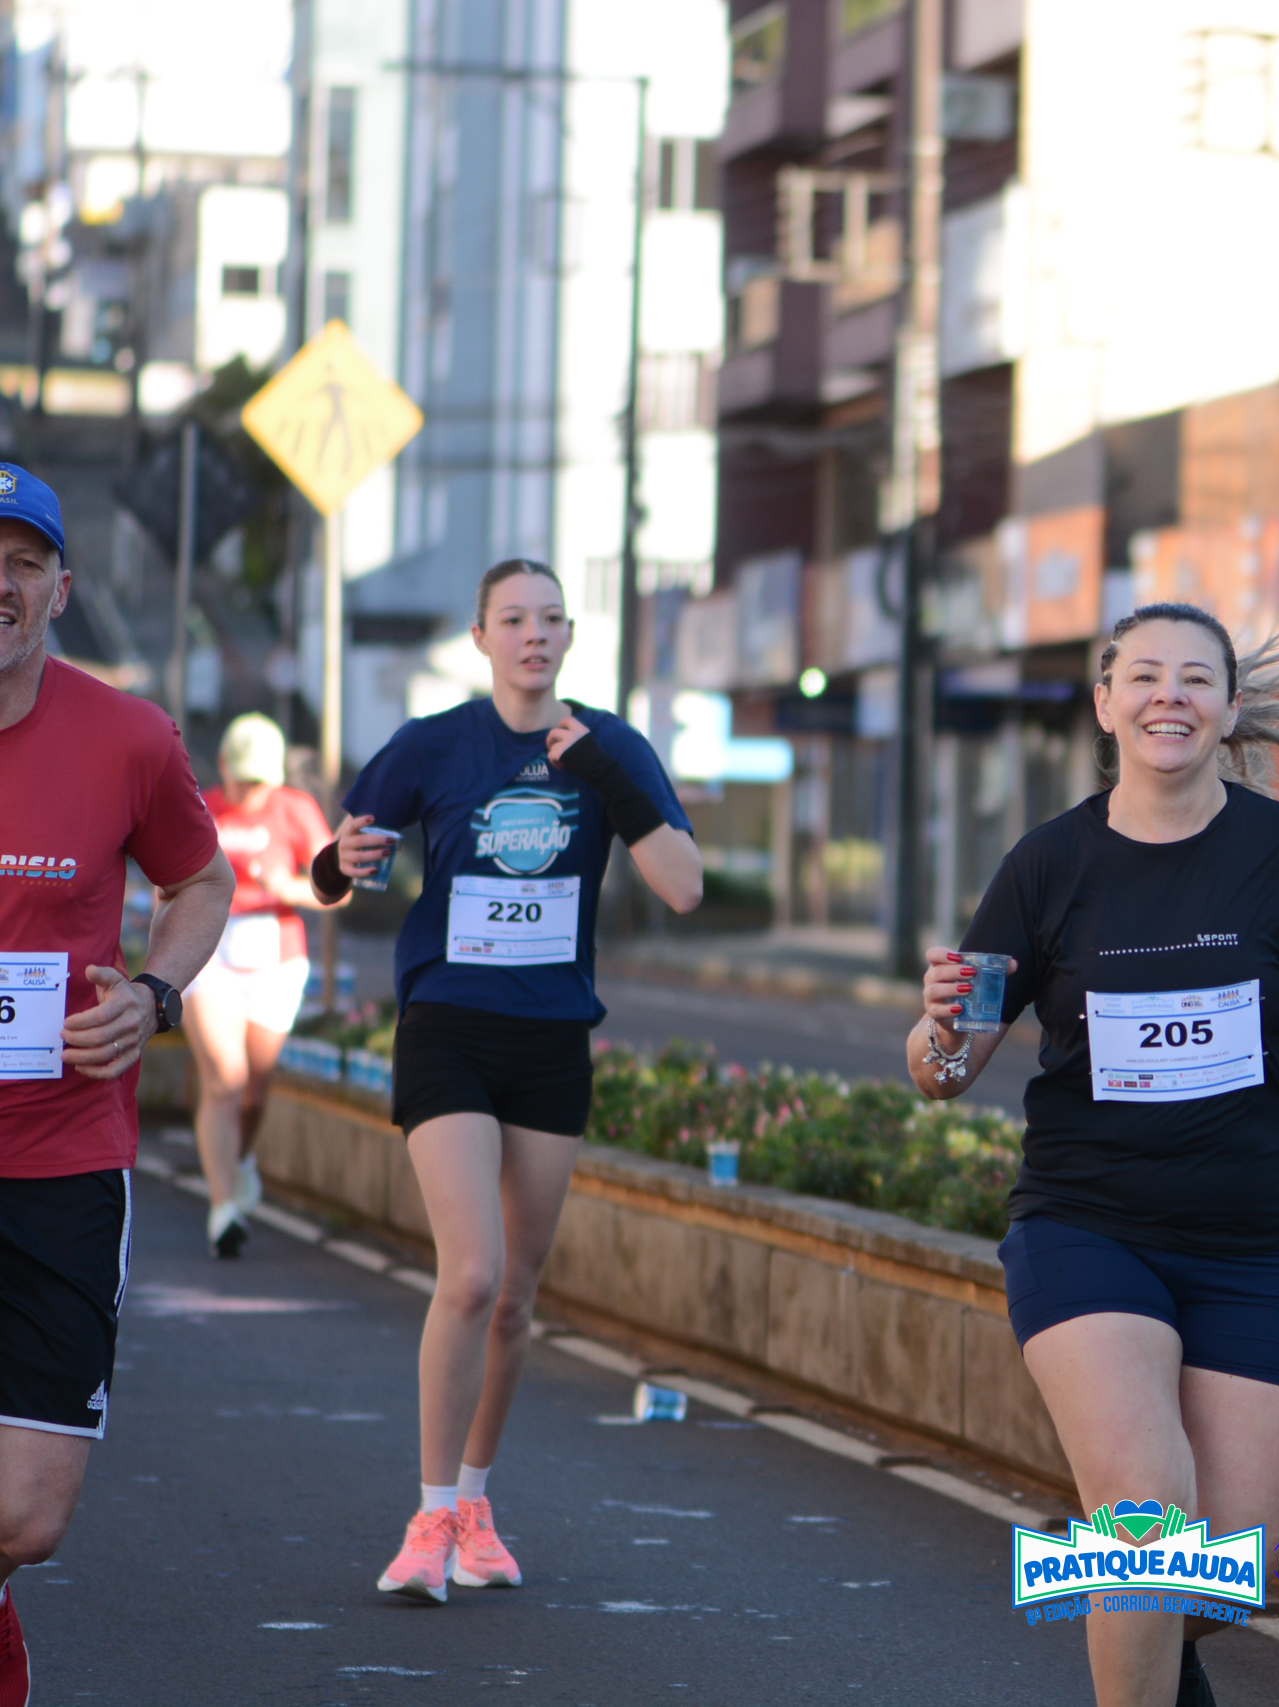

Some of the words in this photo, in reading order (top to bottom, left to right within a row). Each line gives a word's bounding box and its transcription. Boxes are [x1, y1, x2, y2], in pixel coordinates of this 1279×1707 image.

[475, 820, 571, 857] SUPERAÇÃO
[487, 901, 543, 923] 220
[0, 995, 16, 1024] 6
[1218, 999, 1241, 1008] CAUSA
[1139, 1019, 1213, 1049] 205
